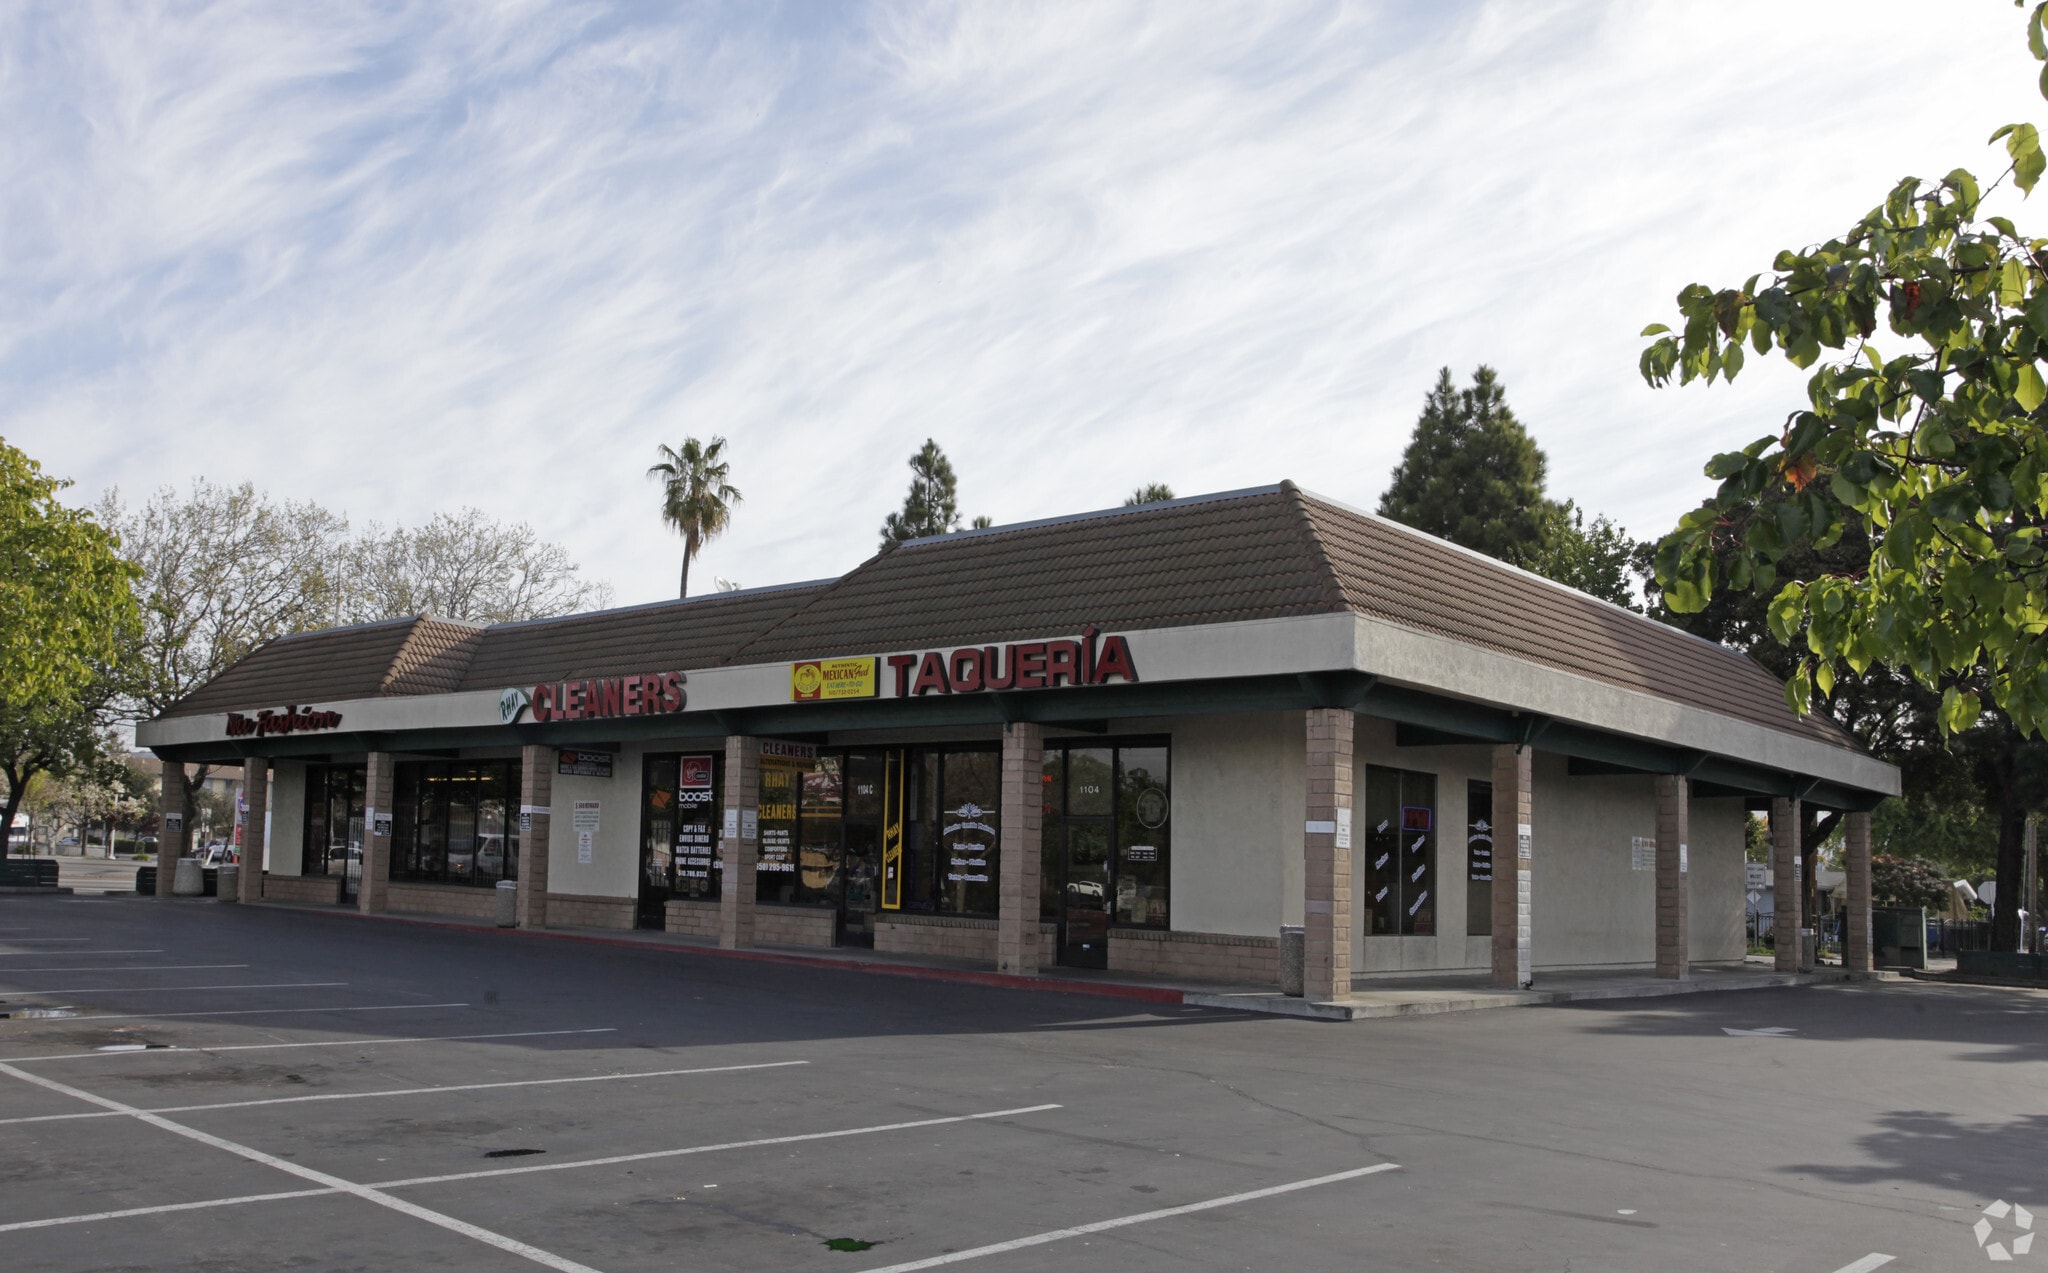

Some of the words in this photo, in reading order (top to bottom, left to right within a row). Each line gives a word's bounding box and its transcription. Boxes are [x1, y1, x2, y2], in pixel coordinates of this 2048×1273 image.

[823, 669, 855, 681] MEXICAN
[854, 664, 870, 679] Food
[500, 691, 519, 721] RHAY
[532, 671, 687, 721] CLEANERS
[256, 705, 343, 737] Fashion
[762, 742, 814, 758] CLEANERS
[764, 772, 791, 788] RHAY
[679, 790, 713, 802] boost
[1079, 786, 1100, 794] 1104
[758, 804, 797, 820] CLEANERS
[683, 824, 694, 833] COPY
[697, 825, 706, 834] FAX
[887, 822, 899, 840] RHAY
[675, 846, 690, 854] WATCH
[690, 846, 712, 855] BATTERIES
